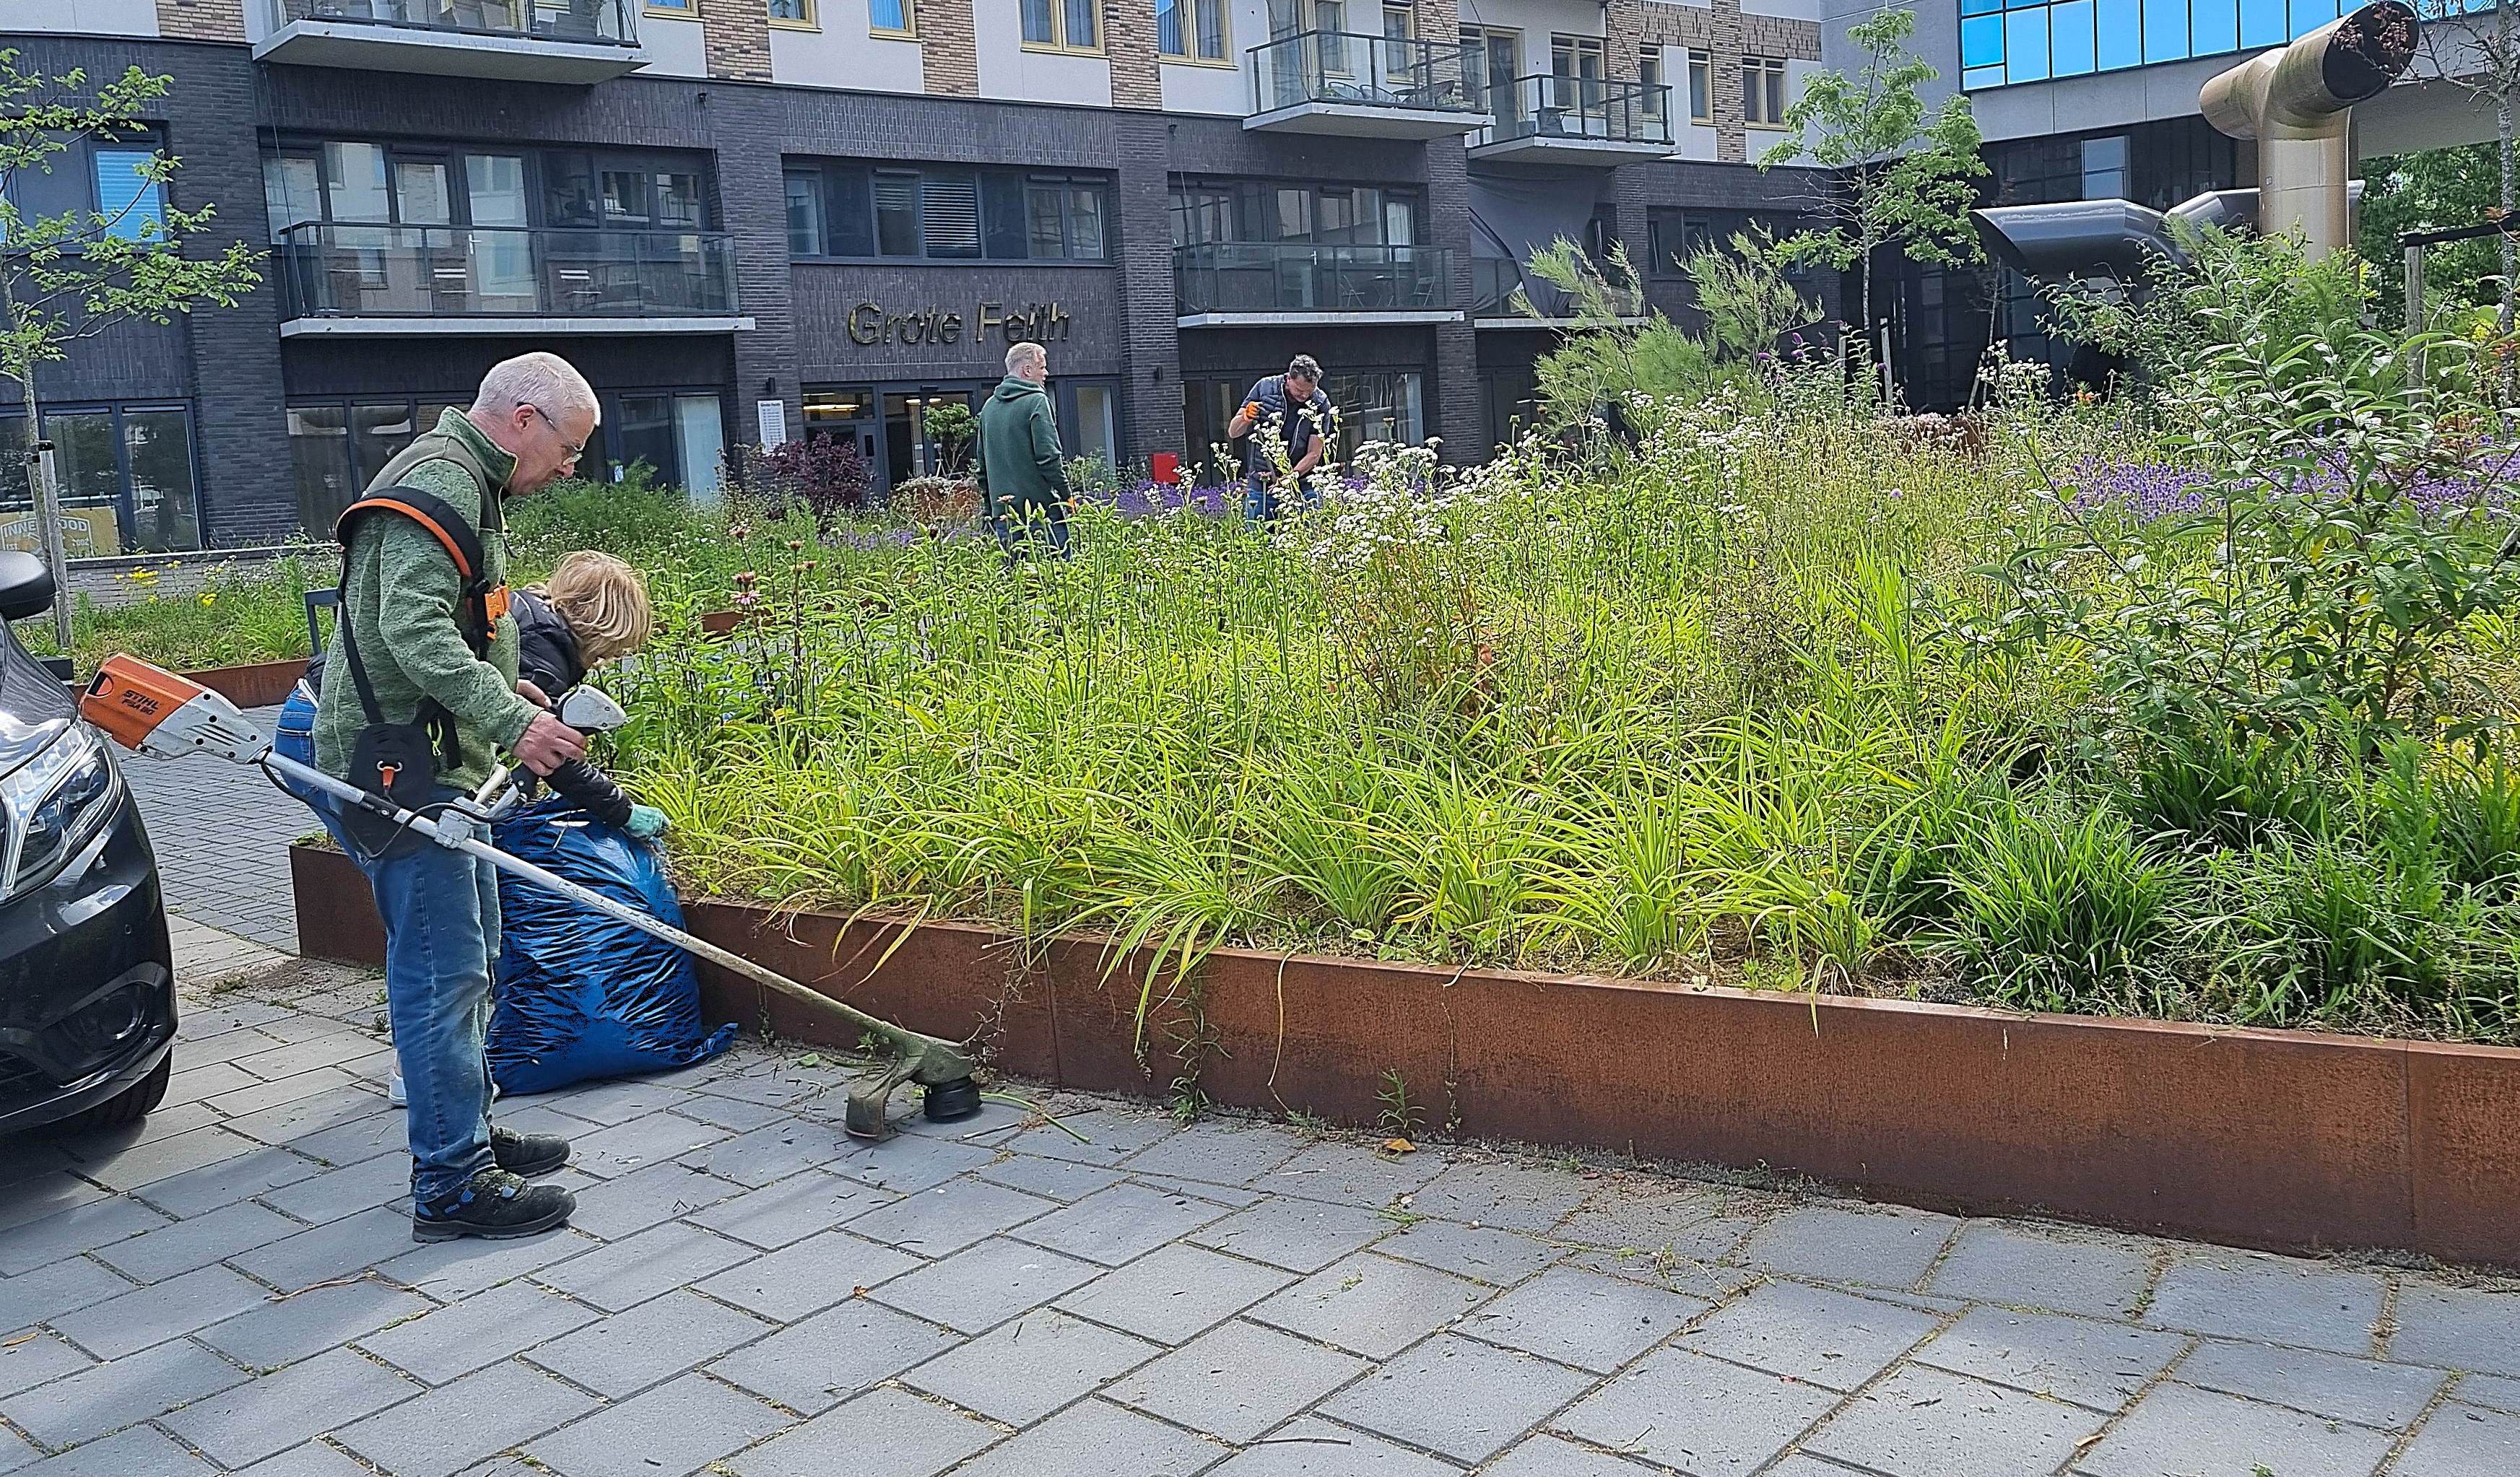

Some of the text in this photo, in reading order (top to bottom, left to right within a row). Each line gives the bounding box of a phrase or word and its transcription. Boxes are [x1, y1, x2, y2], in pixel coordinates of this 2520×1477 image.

[848, 302, 1069, 344] Grote Feith
[4, 519, 87, 537] INNEOOD
[123, 689, 159, 710] STIHL
